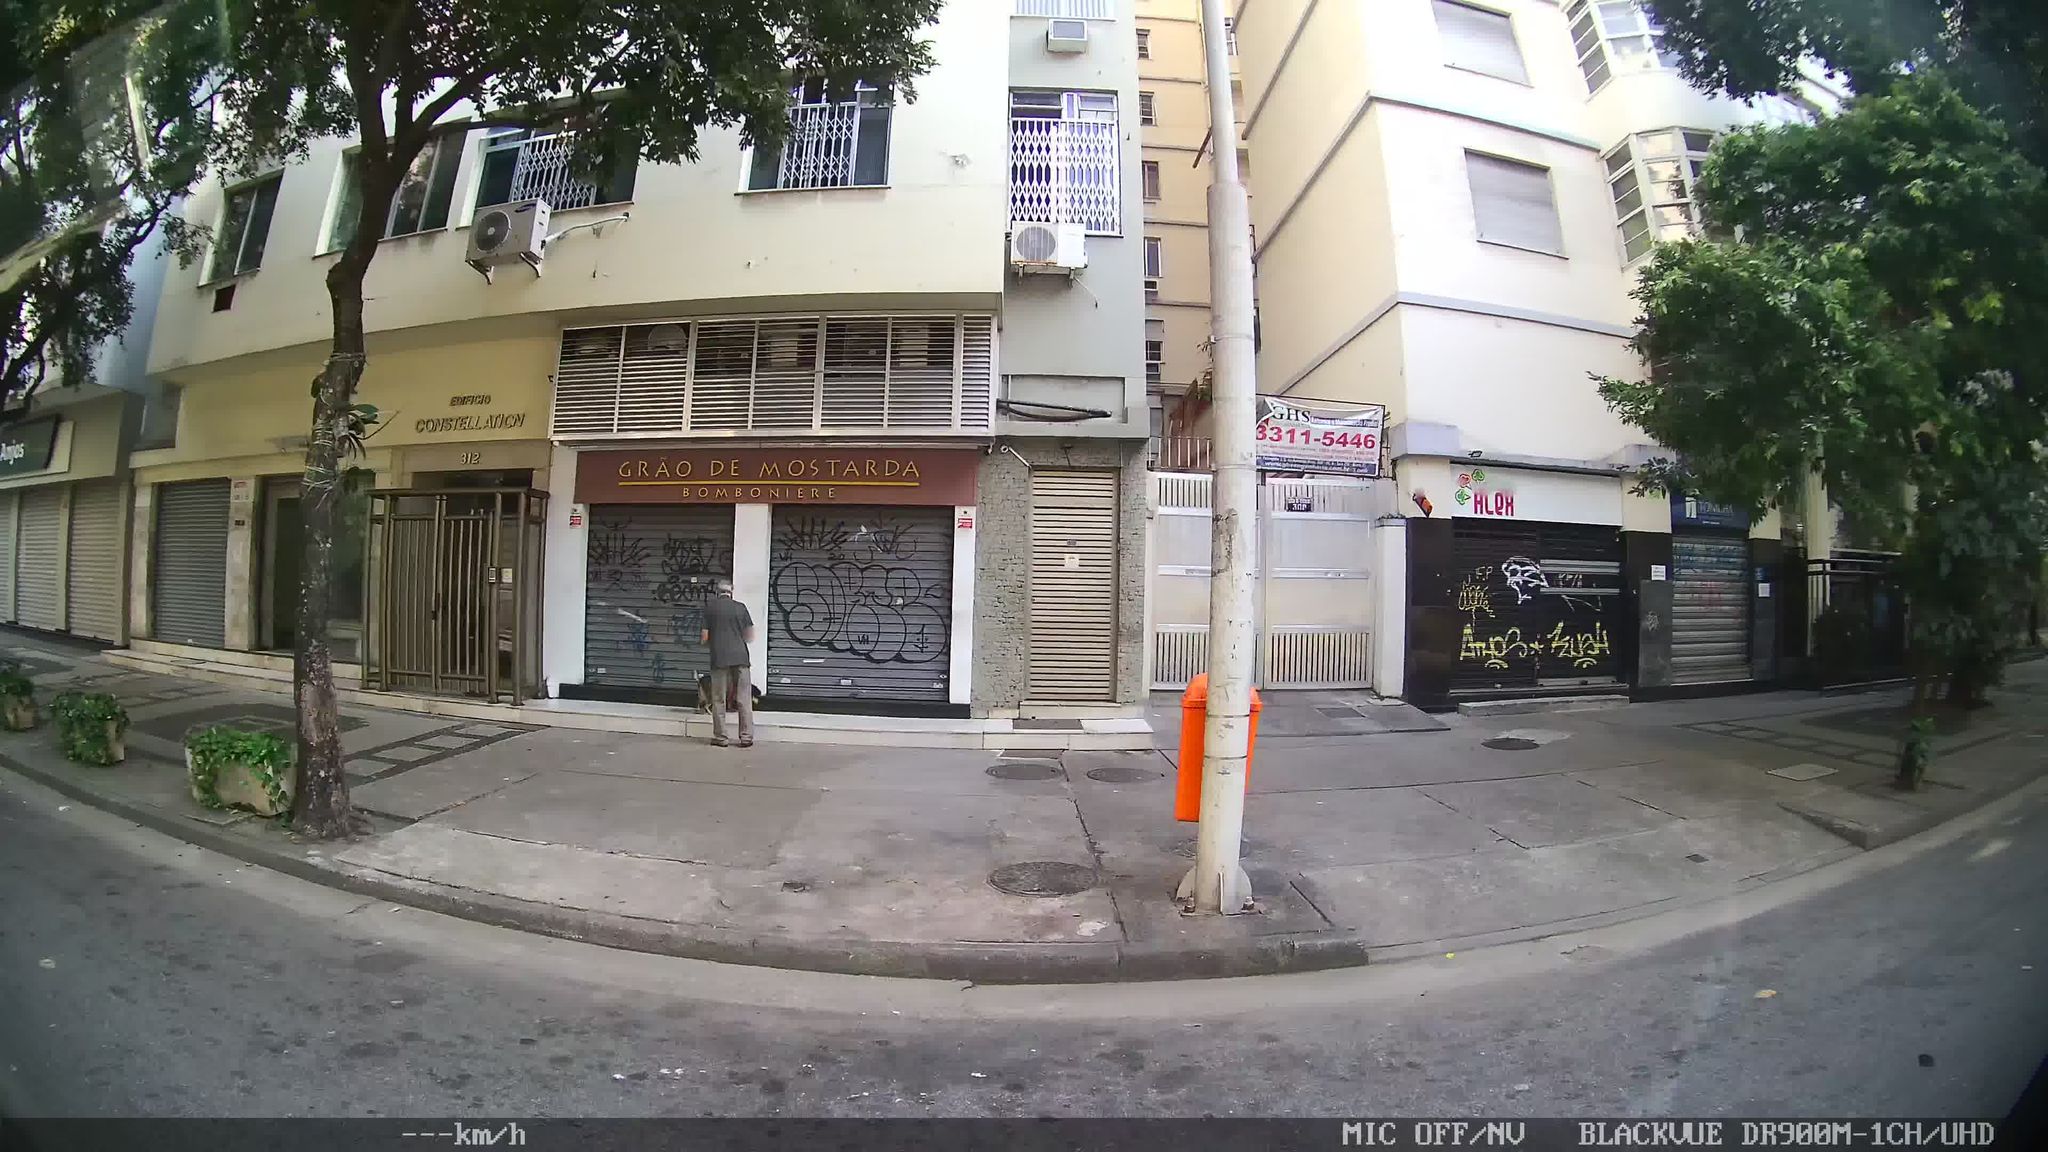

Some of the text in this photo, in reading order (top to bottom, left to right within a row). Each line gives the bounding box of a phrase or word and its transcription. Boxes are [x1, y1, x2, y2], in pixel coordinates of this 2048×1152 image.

[416, 412, 526, 433] CONSTELLATION
[1271, 405, 1311, 423] GHS
[1256, 424, 1376, 449] 3311-5446
[461, 452, 480, 465] 312
[619, 456, 920, 478] GRÃO DE MOSTARDA
[682, 486, 836, 499] BOMBONIERE
